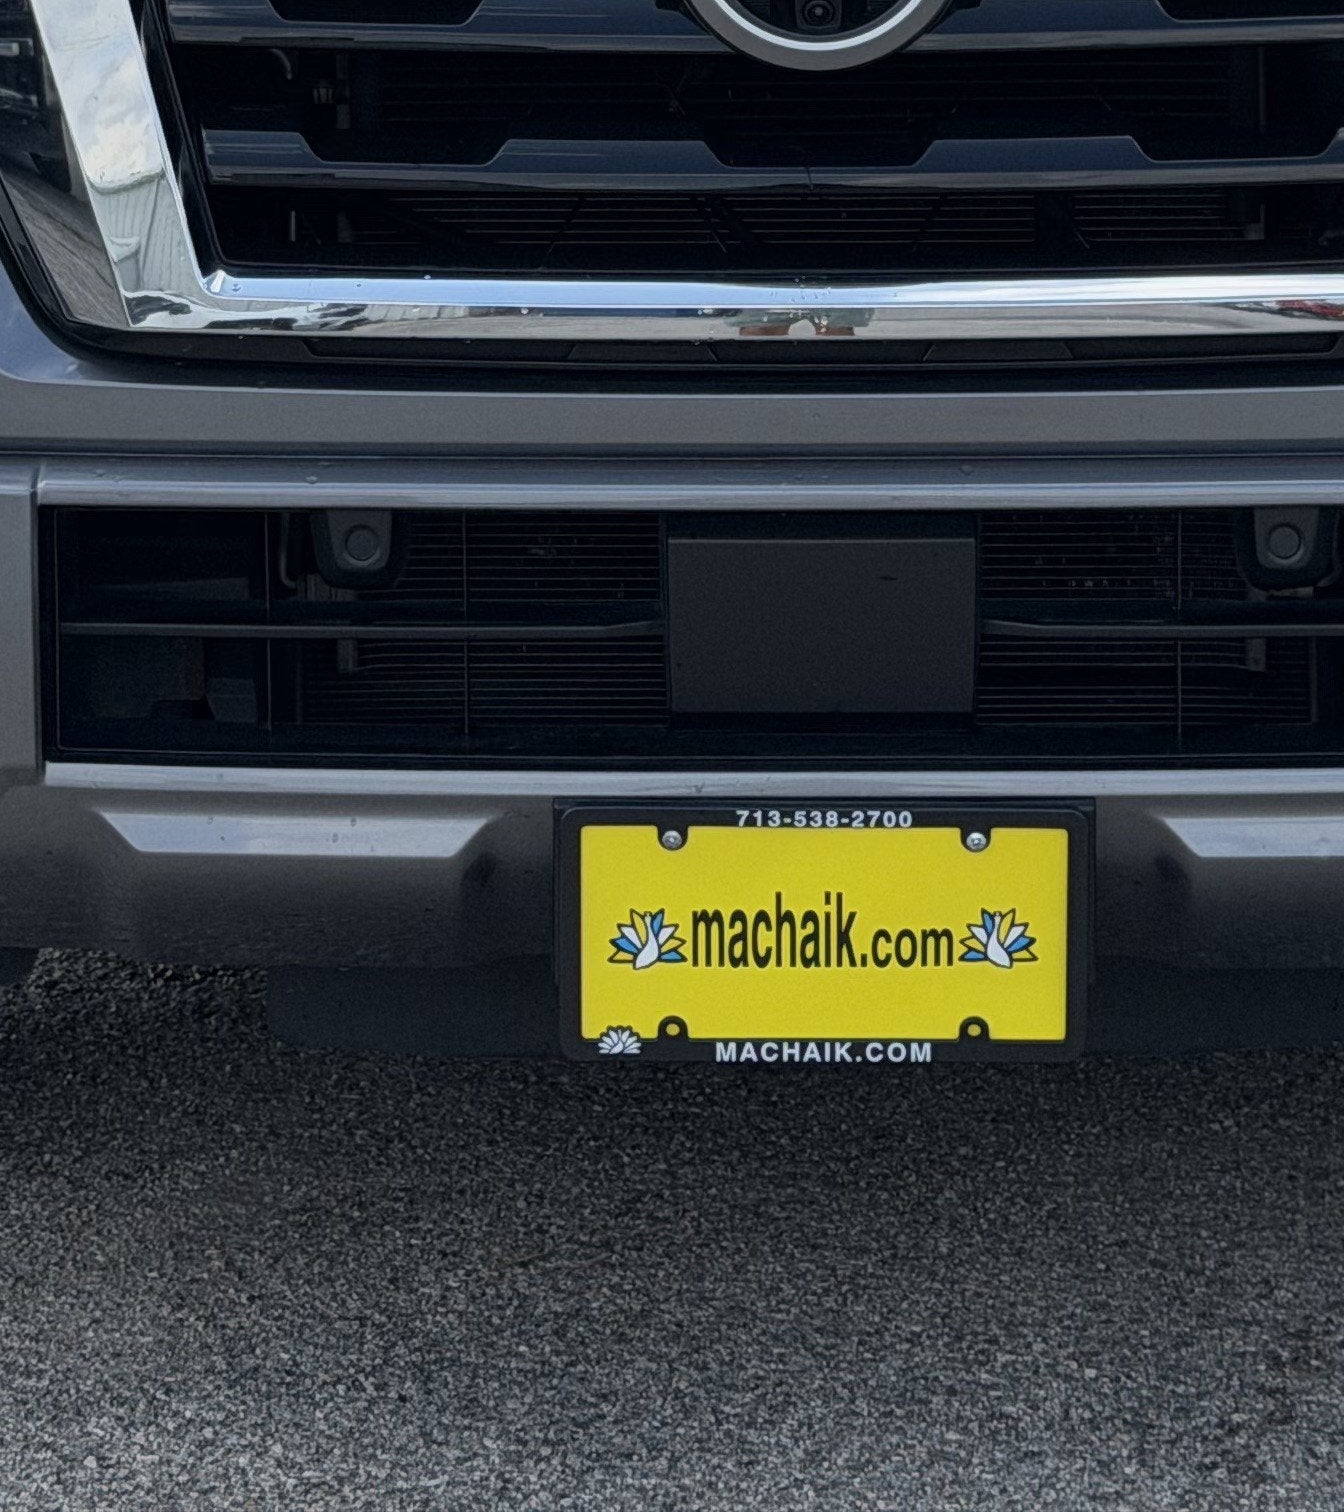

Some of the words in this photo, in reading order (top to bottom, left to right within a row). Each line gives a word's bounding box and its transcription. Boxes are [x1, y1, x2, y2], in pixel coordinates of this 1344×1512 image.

[735, 809, 913, 828] 713-538-2700
[691, 890, 954, 969] machaik.com
[715, 1041, 932, 1063] MACHAIK.COM
